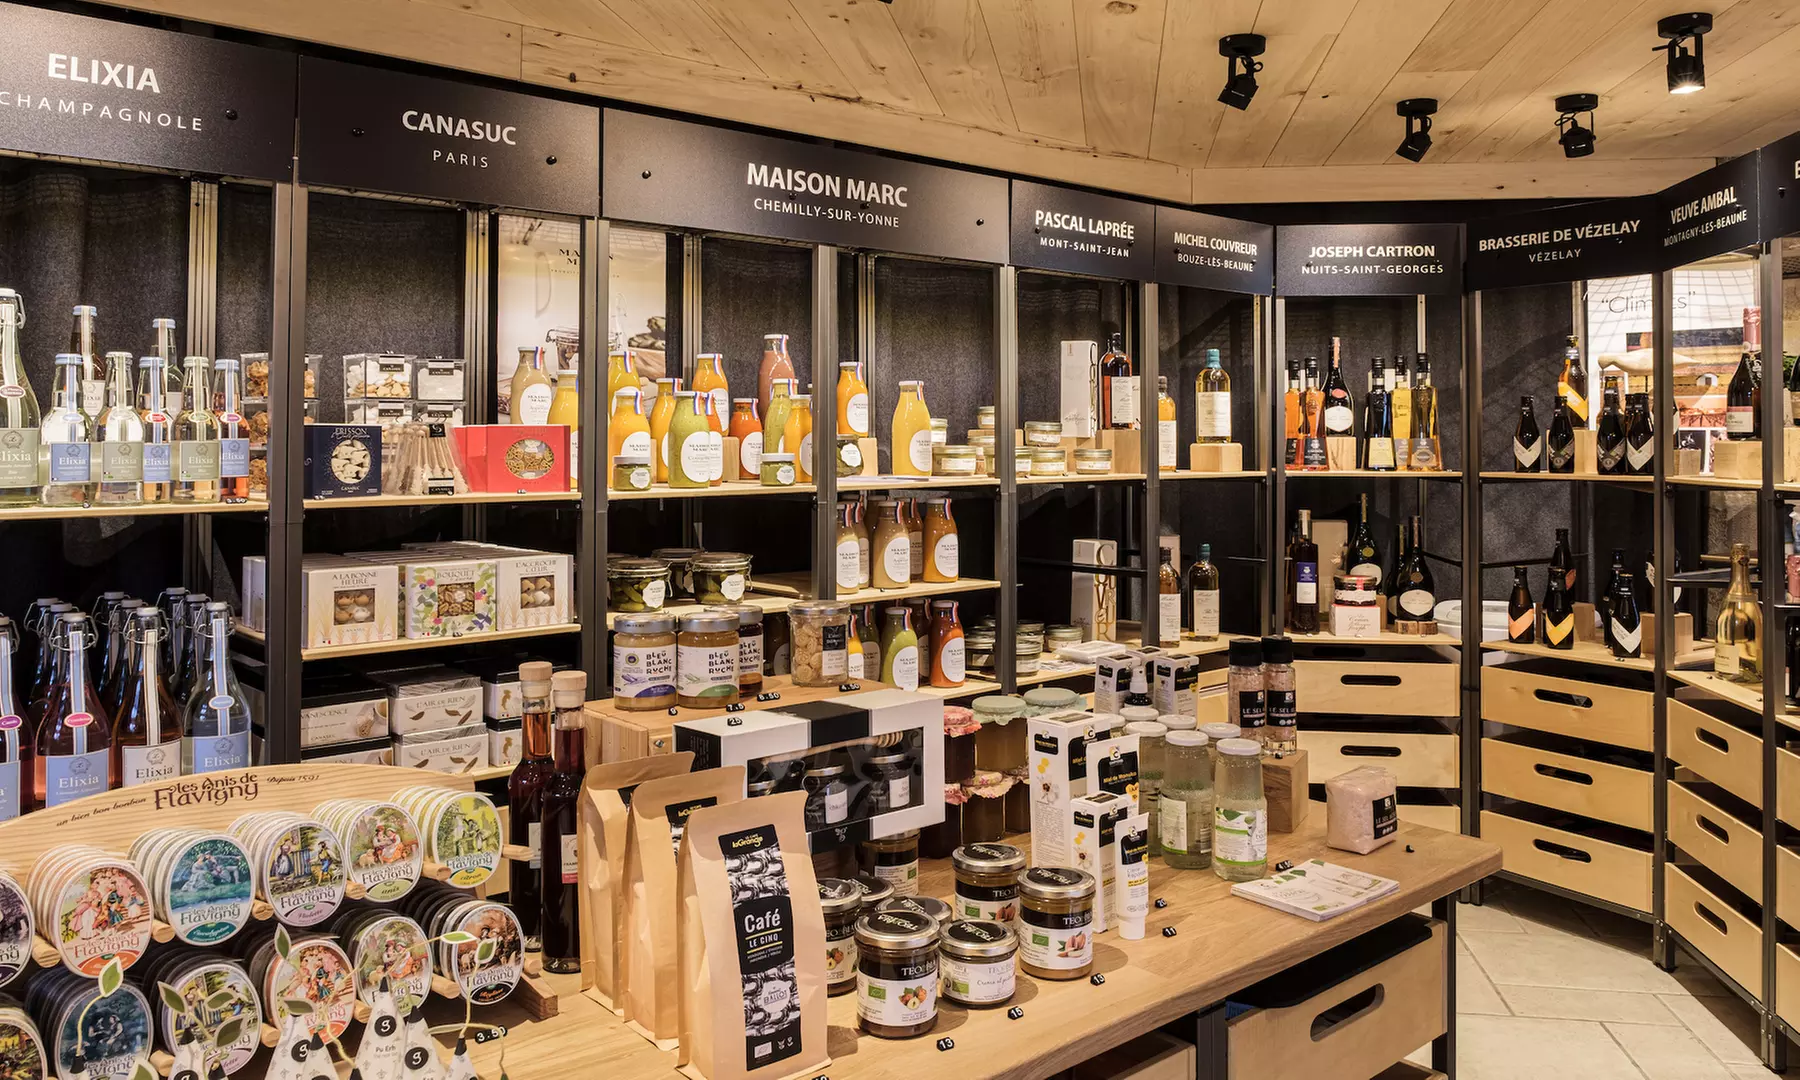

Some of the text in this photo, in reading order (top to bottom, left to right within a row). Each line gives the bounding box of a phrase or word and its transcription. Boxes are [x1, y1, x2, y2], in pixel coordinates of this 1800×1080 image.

[48, 53, 160, 94] ELIXIA
[0, 91, 202, 131] CHAMPAGNOLE
[402, 110, 517, 146] CANASUC
[433, 150, 489, 168] PARIS
[747, 162, 908, 208] MAISON MARC
[754, 198, 899, 228] CHEMILLY-SUR-YONNE
[1670, 186, 1737, 225] VEUVE AMBAL
[1035, 210, 1135, 240] PASCAL LAPRÉE
[1664, 210, 1748, 247] MONTAGNY-LES-BEAUNE
[1174, 232, 1258, 256] MICHEL COUVREUR
[1479, 219, 1641, 251] BRASSERIE DE VÉZELAY
[1040, 237, 1130, 258] MONT-SAINT-JEAN
[1309, 245, 1436, 258] JOSEPH CARTRON
[1528, 248, 1582, 263] VÉZELAY
[1177, 253, 1254, 273] BOUZE-LÈS-BEAUNE
[1301, 264, 1444, 275] NUITS-SAINT-GEORGES
[0, 450, 31, 462] lixia
[59, 456, 87, 465] Elixia
[144, 457, 169, 467] Elixia
[188, 456, 213, 465] Elixia
[437, 570, 475, 579] BOUQUET
[739, 648, 761, 656] BLANC
[646, 657, 672, 667] BLANC
[709, 658, 734, 667] BLANC
[204, 755, 241, 768] Elixia
[136, 766, 173, 778] Elixia
[266, 776, 296, 785] Depuis
[59, 776, 99, 788] Elixia
[177, 772, 258, 793] les Anis de
[155, 783, 259, 811] Flavigny
[56, 797, 147, 827] un bien bon bonbon
[362, 866, 414, 885] Flavigny
[280, 889, 336, 909] Flavigny
[381, 886, 400, 895] anis
[180, 907, 241, 926] Flavigny
[744, 908, 781, 933] Café
[74, 938, 141, 958] Flavigny
[749, 933, 779, 948] LE CINQ
[1093, 973, 1105, 984] 13
[1010, 1006, 1022, 1018] 15
[939, 1037, 954, 1051] 13
